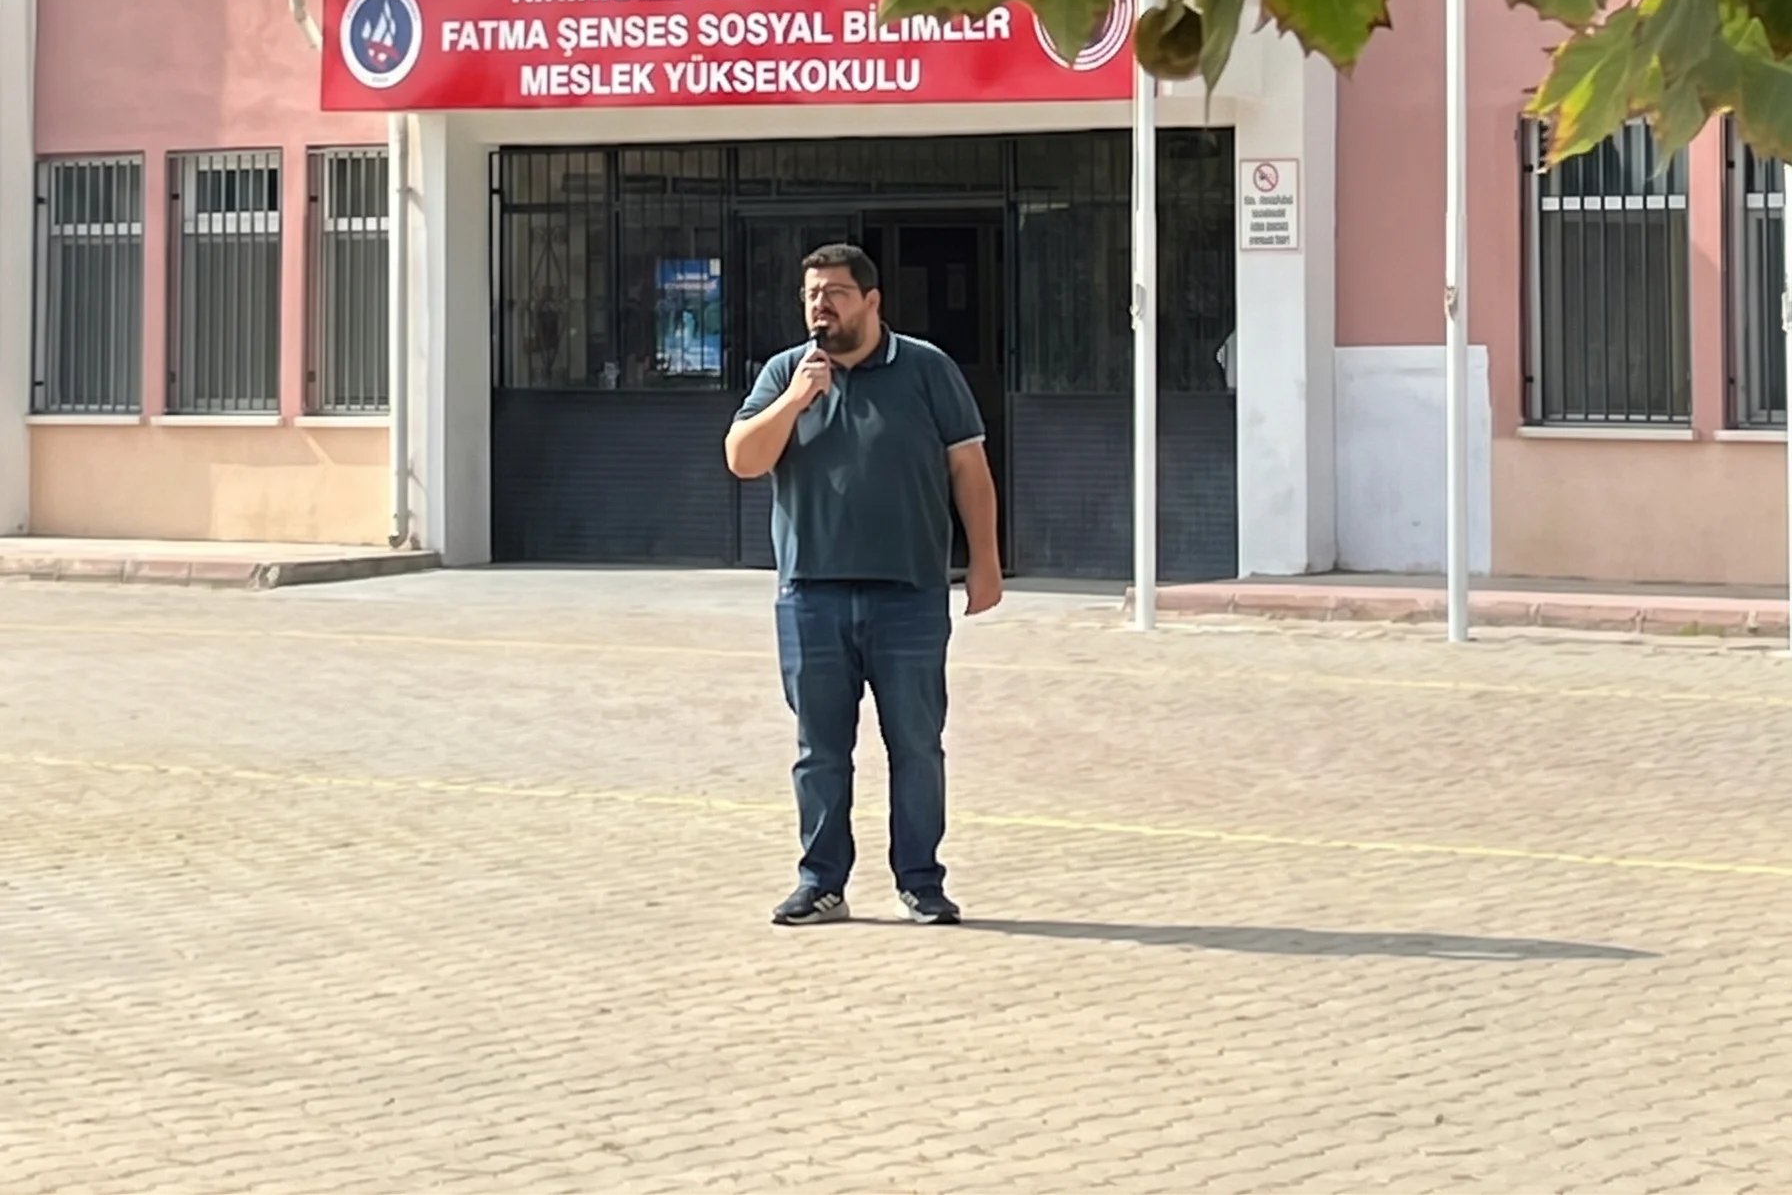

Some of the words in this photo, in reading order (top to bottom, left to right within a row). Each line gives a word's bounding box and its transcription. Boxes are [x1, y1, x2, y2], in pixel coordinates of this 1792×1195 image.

[441, 19, 549, 52] FATMA
[556, 14, 689, 57] ŞENSES
[697, 11, 834, 47] SOSYAL
[520, 62, 656, 96] MESLEK
[662, 54, 921, 95] YÜKSEKOKULU
